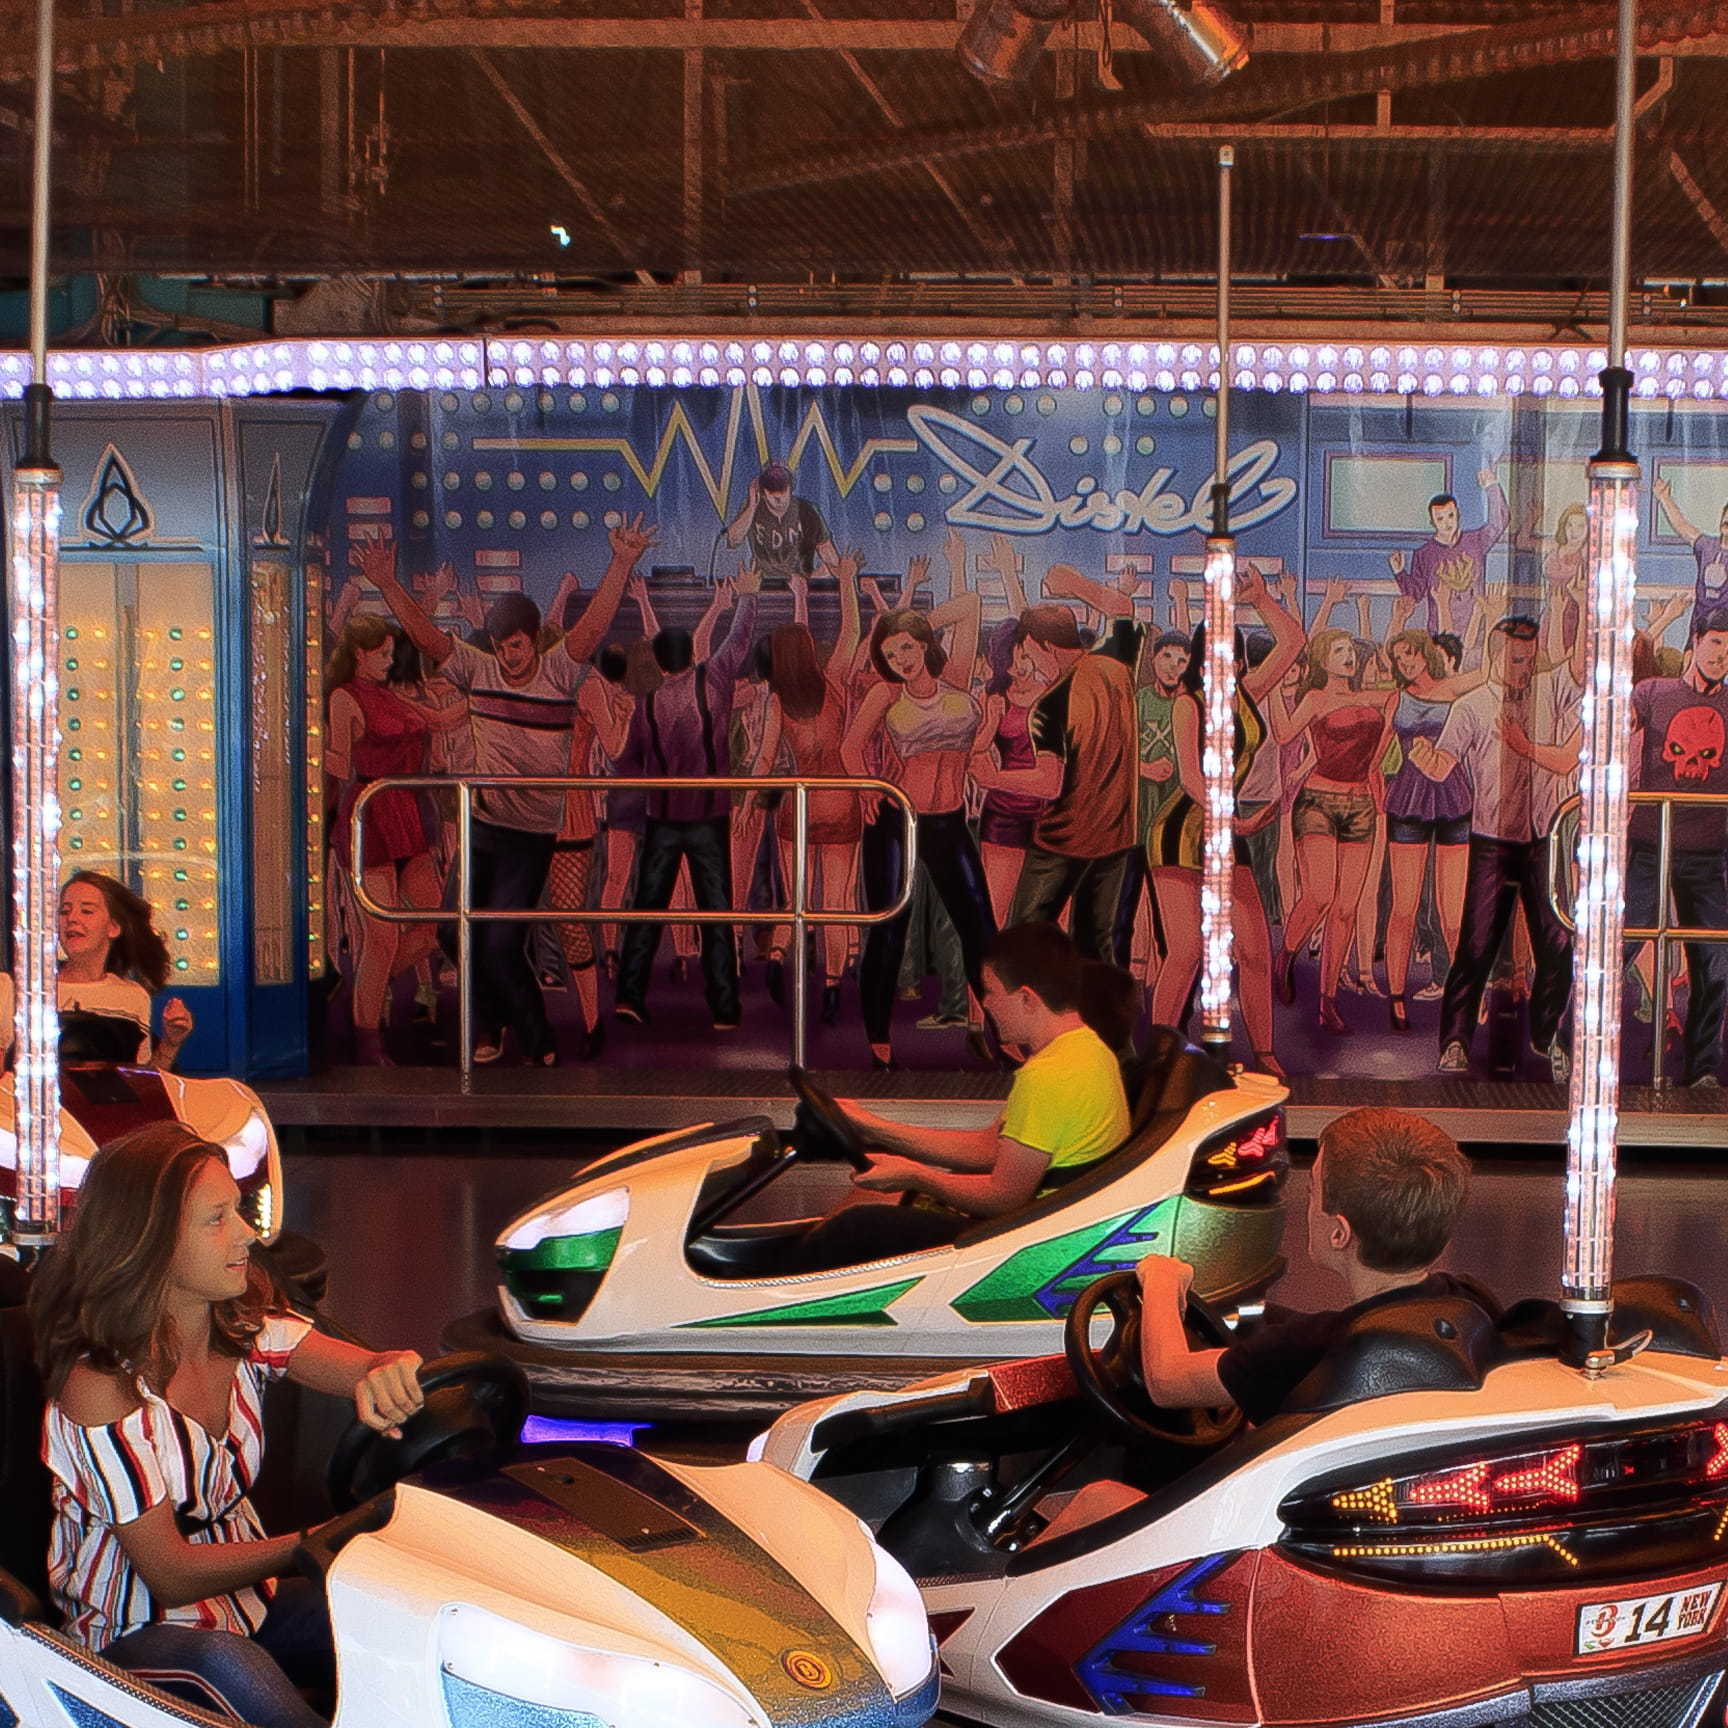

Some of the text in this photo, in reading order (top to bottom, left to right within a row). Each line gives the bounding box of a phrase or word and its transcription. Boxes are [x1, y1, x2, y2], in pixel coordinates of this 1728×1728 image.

[1680, 1590, 1713, 1615] NEW
[1624, 1597, 1676, 1643] 14
[1677, 1607, 1708, 1631] YORK
